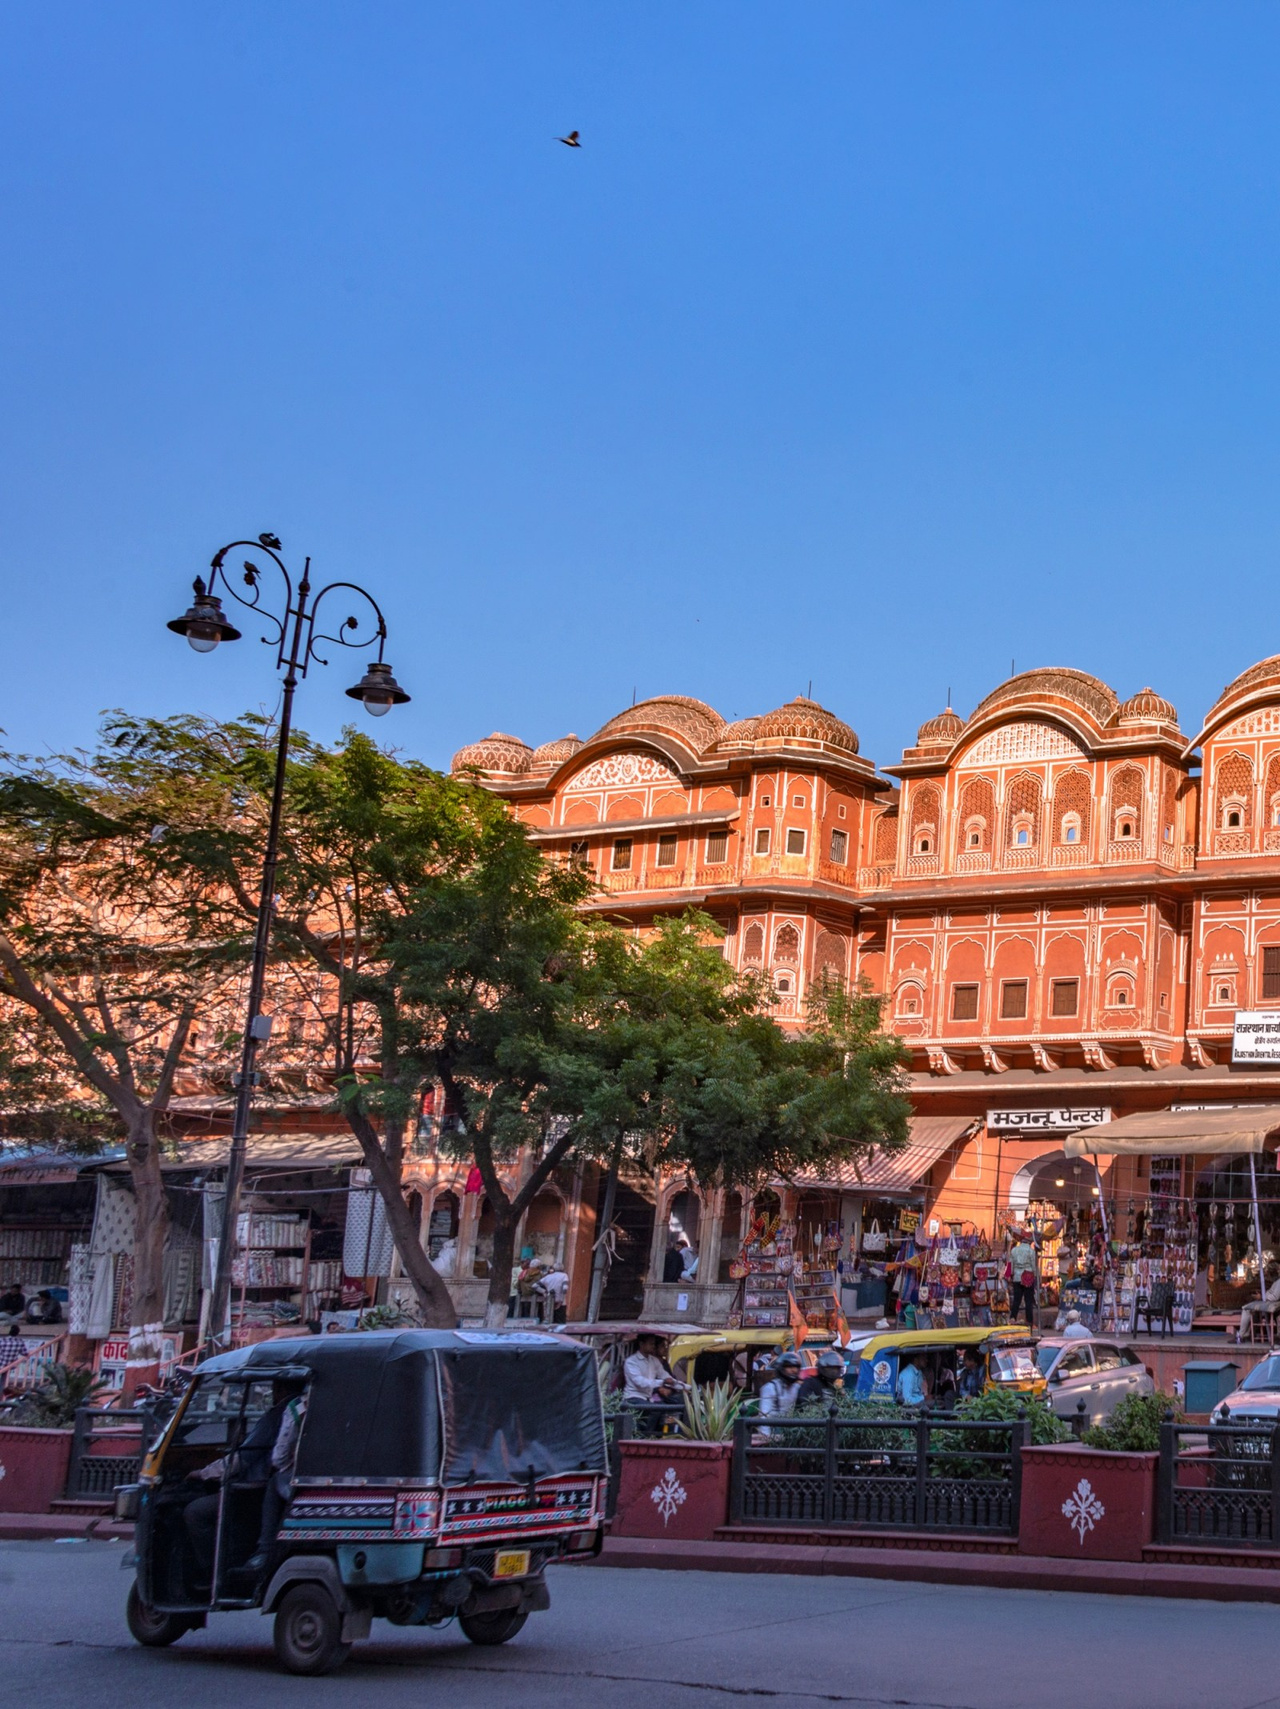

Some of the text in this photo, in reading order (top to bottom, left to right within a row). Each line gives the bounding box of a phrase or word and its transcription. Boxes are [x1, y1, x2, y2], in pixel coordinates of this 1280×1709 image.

[1236, 1024, 1264, 1033] राजस्थान
[993, 1107, 1105, 1126] मजनू पेन्टर्स
